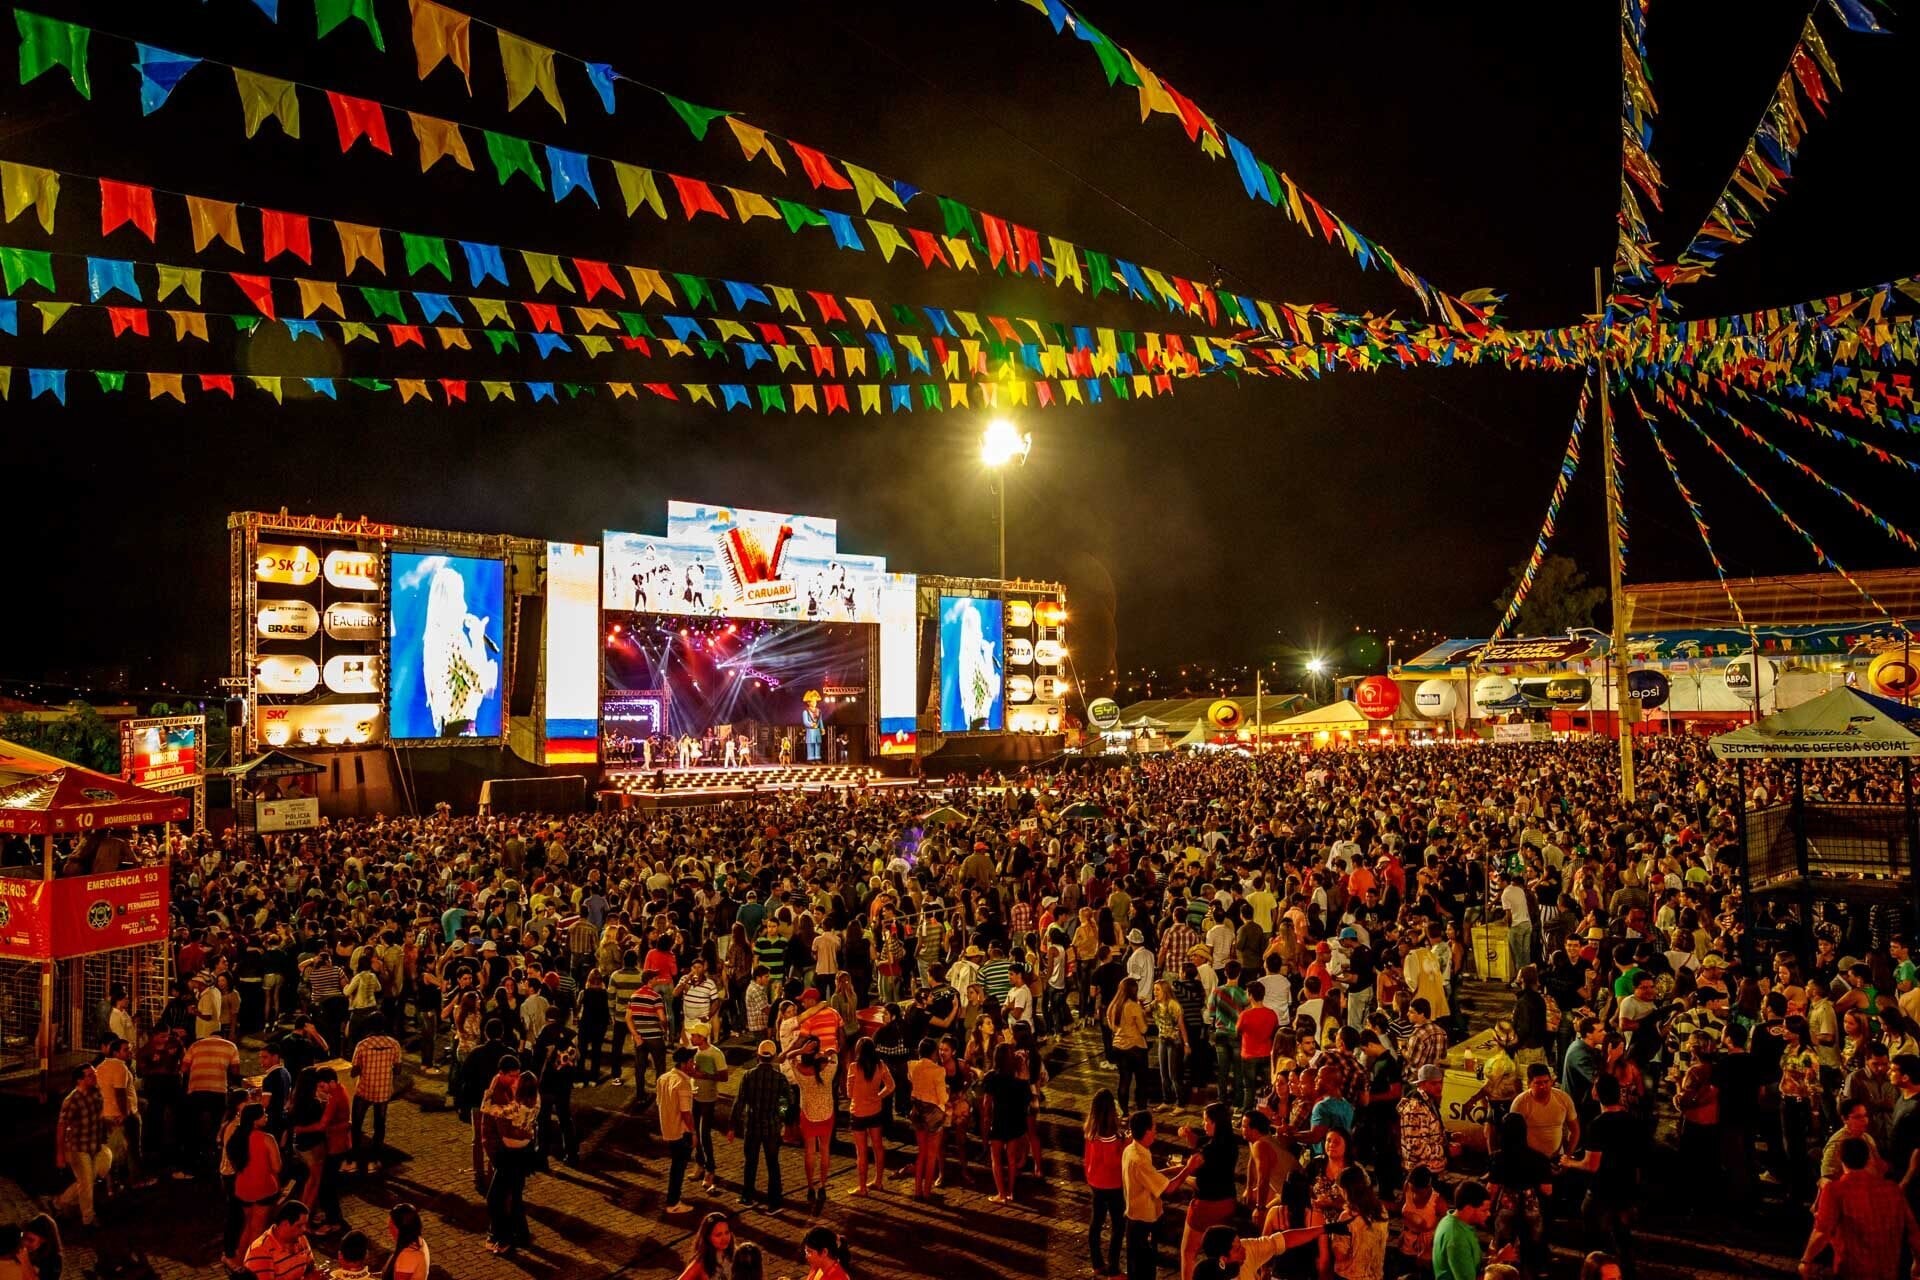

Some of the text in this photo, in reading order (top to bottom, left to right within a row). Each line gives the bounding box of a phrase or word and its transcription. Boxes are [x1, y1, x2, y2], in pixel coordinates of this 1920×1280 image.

[278, 559, 311, 573] SKOL
[747, 585, 791, 600] CARUARU
[268, 624, 307, 633] BRASIL
[1726, 674, 1749, 683] ABPA
[266, 710, 288, 719] SKY
[1776, 728, 1862, 736] Pernambuco
[1721, 741, 1910, 753] SECRETARIA DE DEFESA SOCIAL
[76, 812, 94, 828] 10
[104, 813, 141, 825] BOMBEIROS
[87, 872, 158, 891] EMERGÊNCIA 193
[1449, 1102, 1488, 1124] SKO
